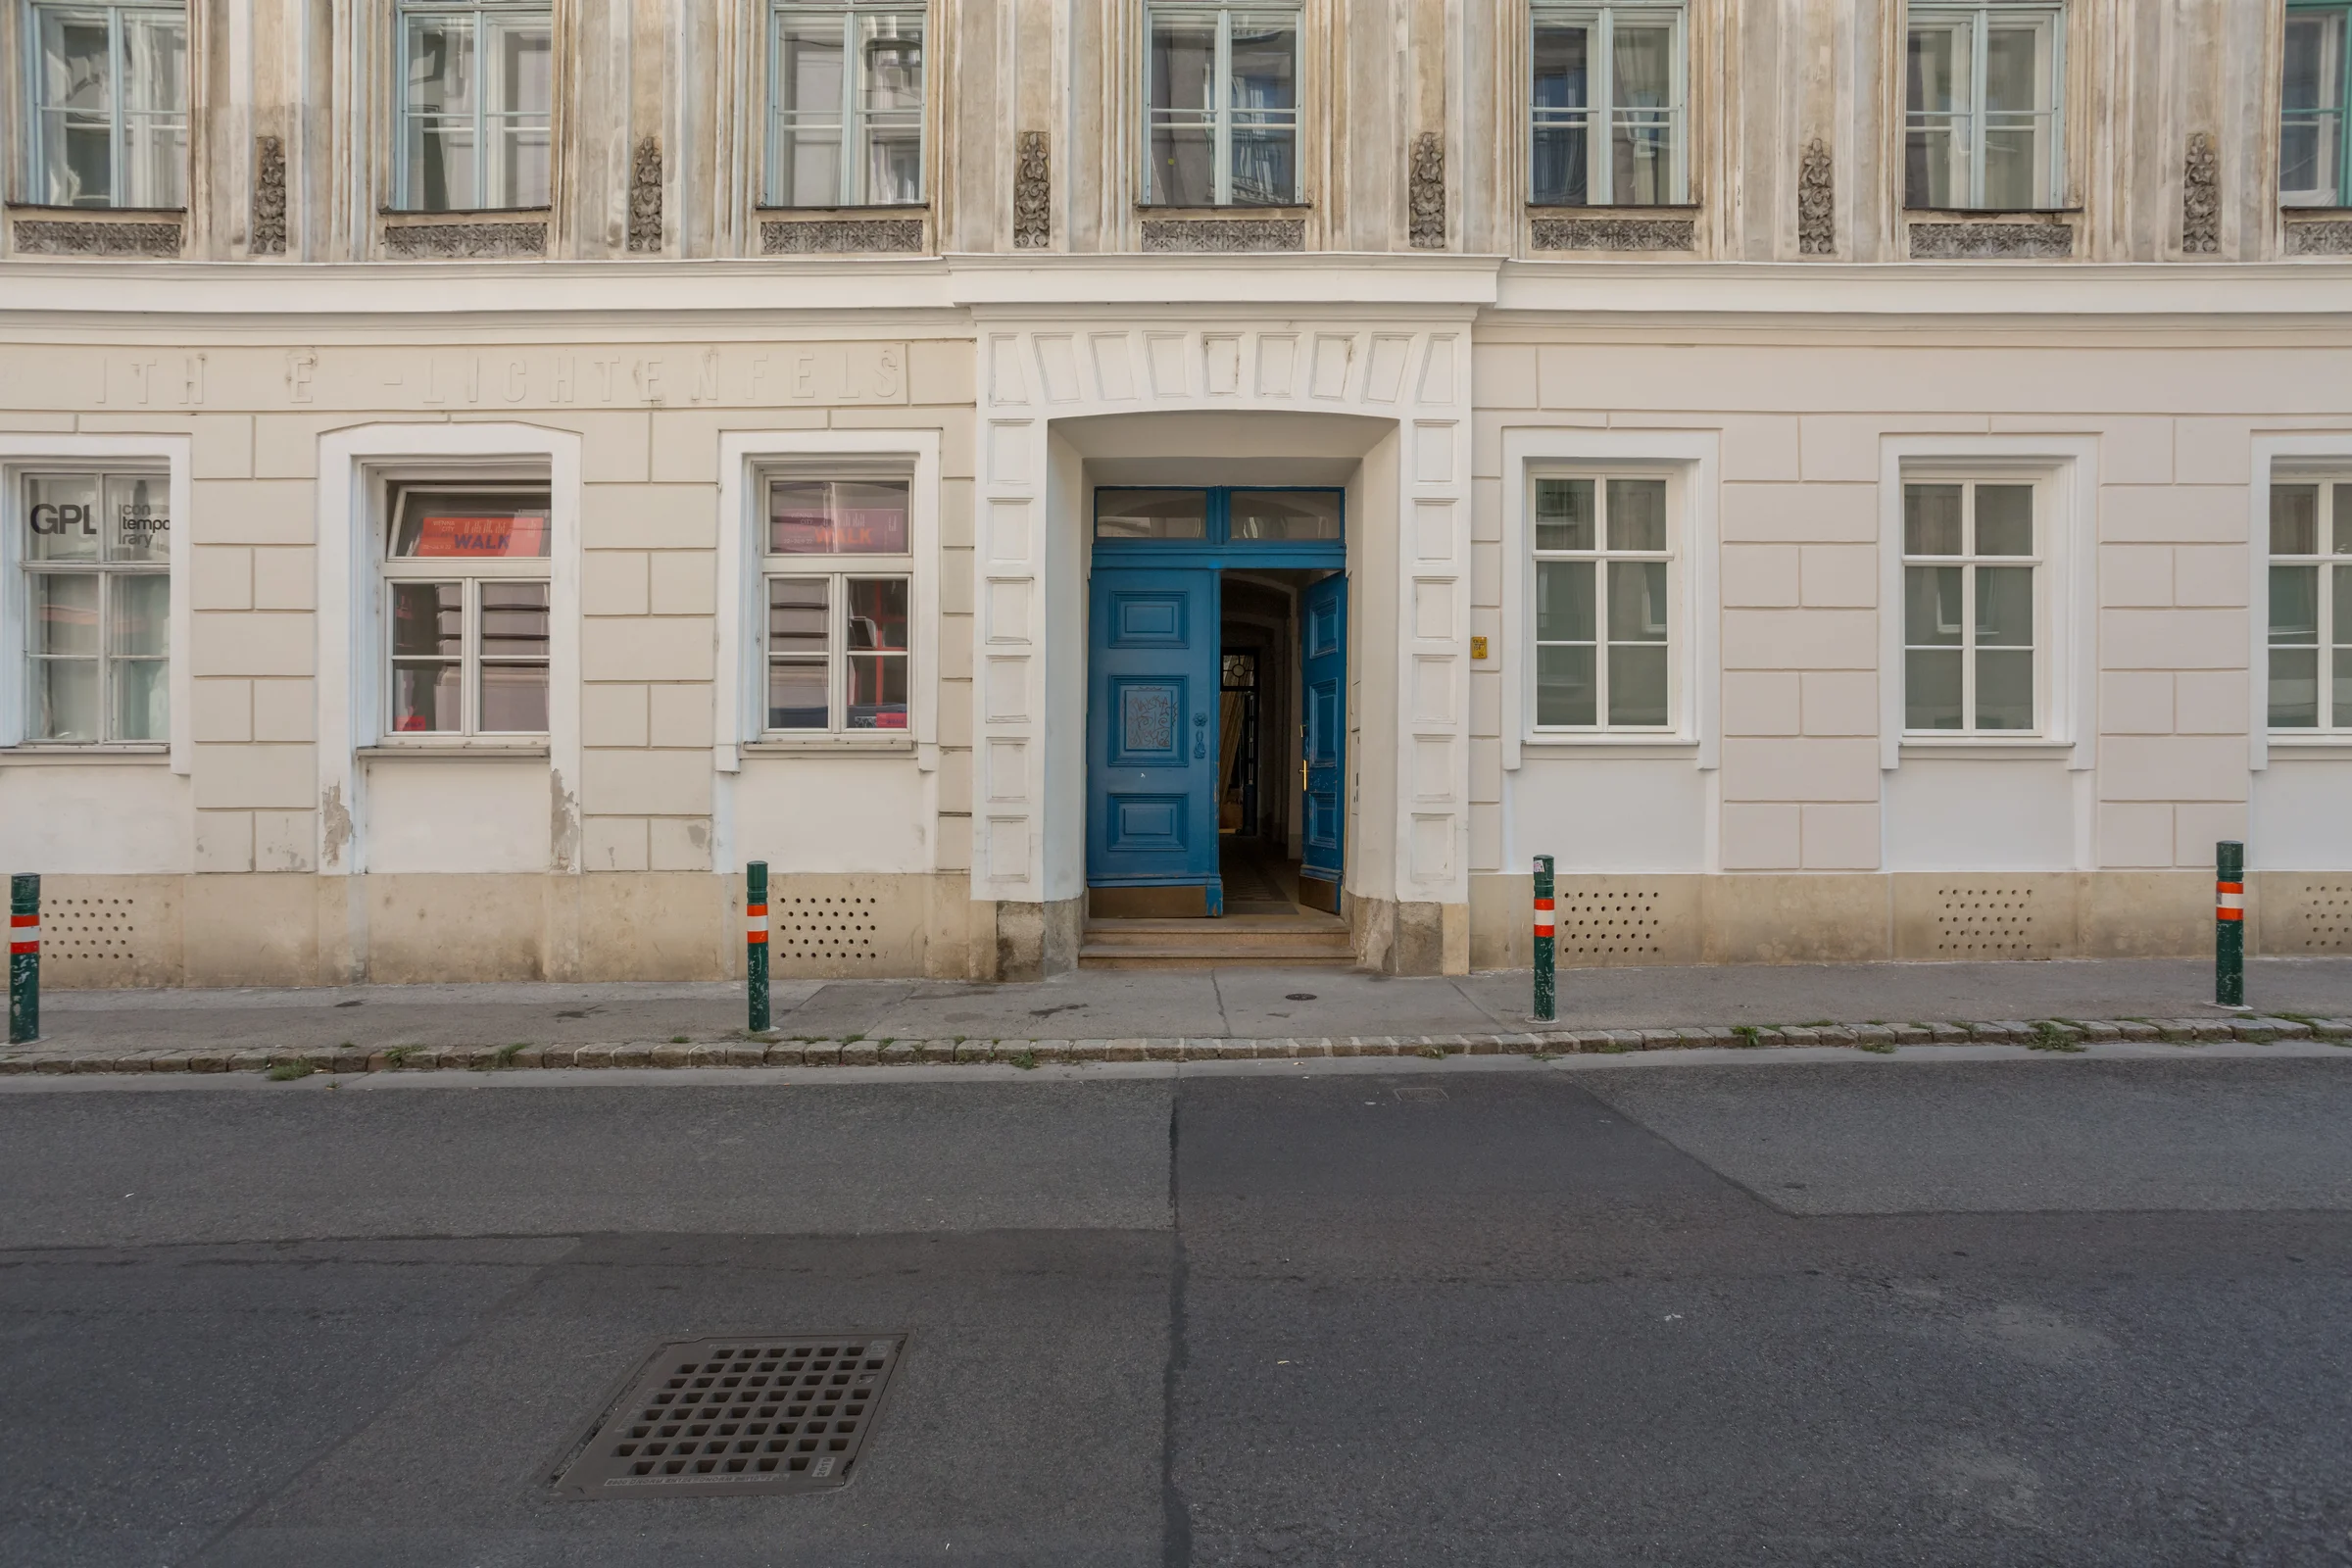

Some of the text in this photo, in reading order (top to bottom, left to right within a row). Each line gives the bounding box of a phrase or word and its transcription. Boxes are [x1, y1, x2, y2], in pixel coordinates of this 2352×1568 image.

[122, 504, 151, 515] con
[30, 503, 98, 535] GPL
[122, 534, 154, 549] rary
[454, 533, 511, 550] WALK
